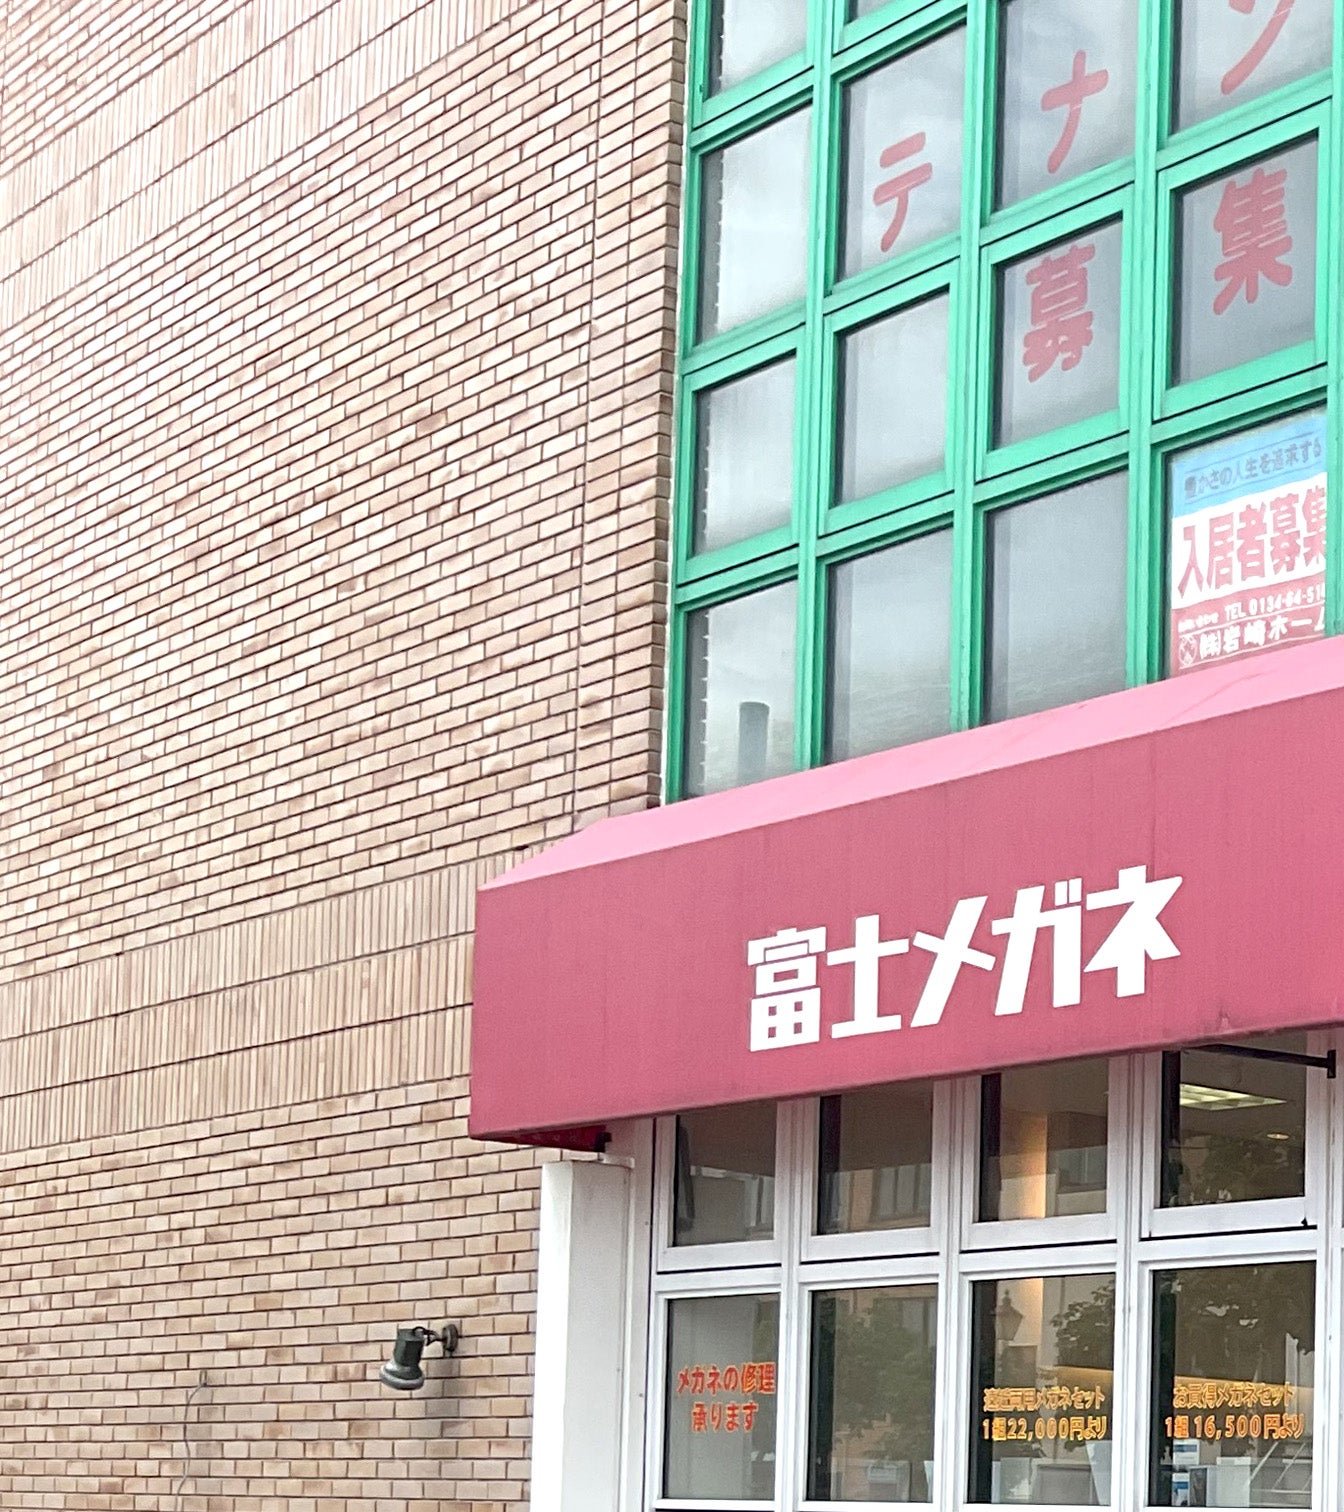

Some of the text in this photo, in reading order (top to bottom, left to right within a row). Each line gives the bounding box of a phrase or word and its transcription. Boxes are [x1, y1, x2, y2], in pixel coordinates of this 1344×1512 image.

[1023, 168, 1293, 383] 募集
[1177, 485, 1326, 600] 入居者募集
[1225, 602, 1247, 621] TEL
[747, 864, 1184, 1053] 富士メガネ
[691, 1400, 760, 1433] 承ります
